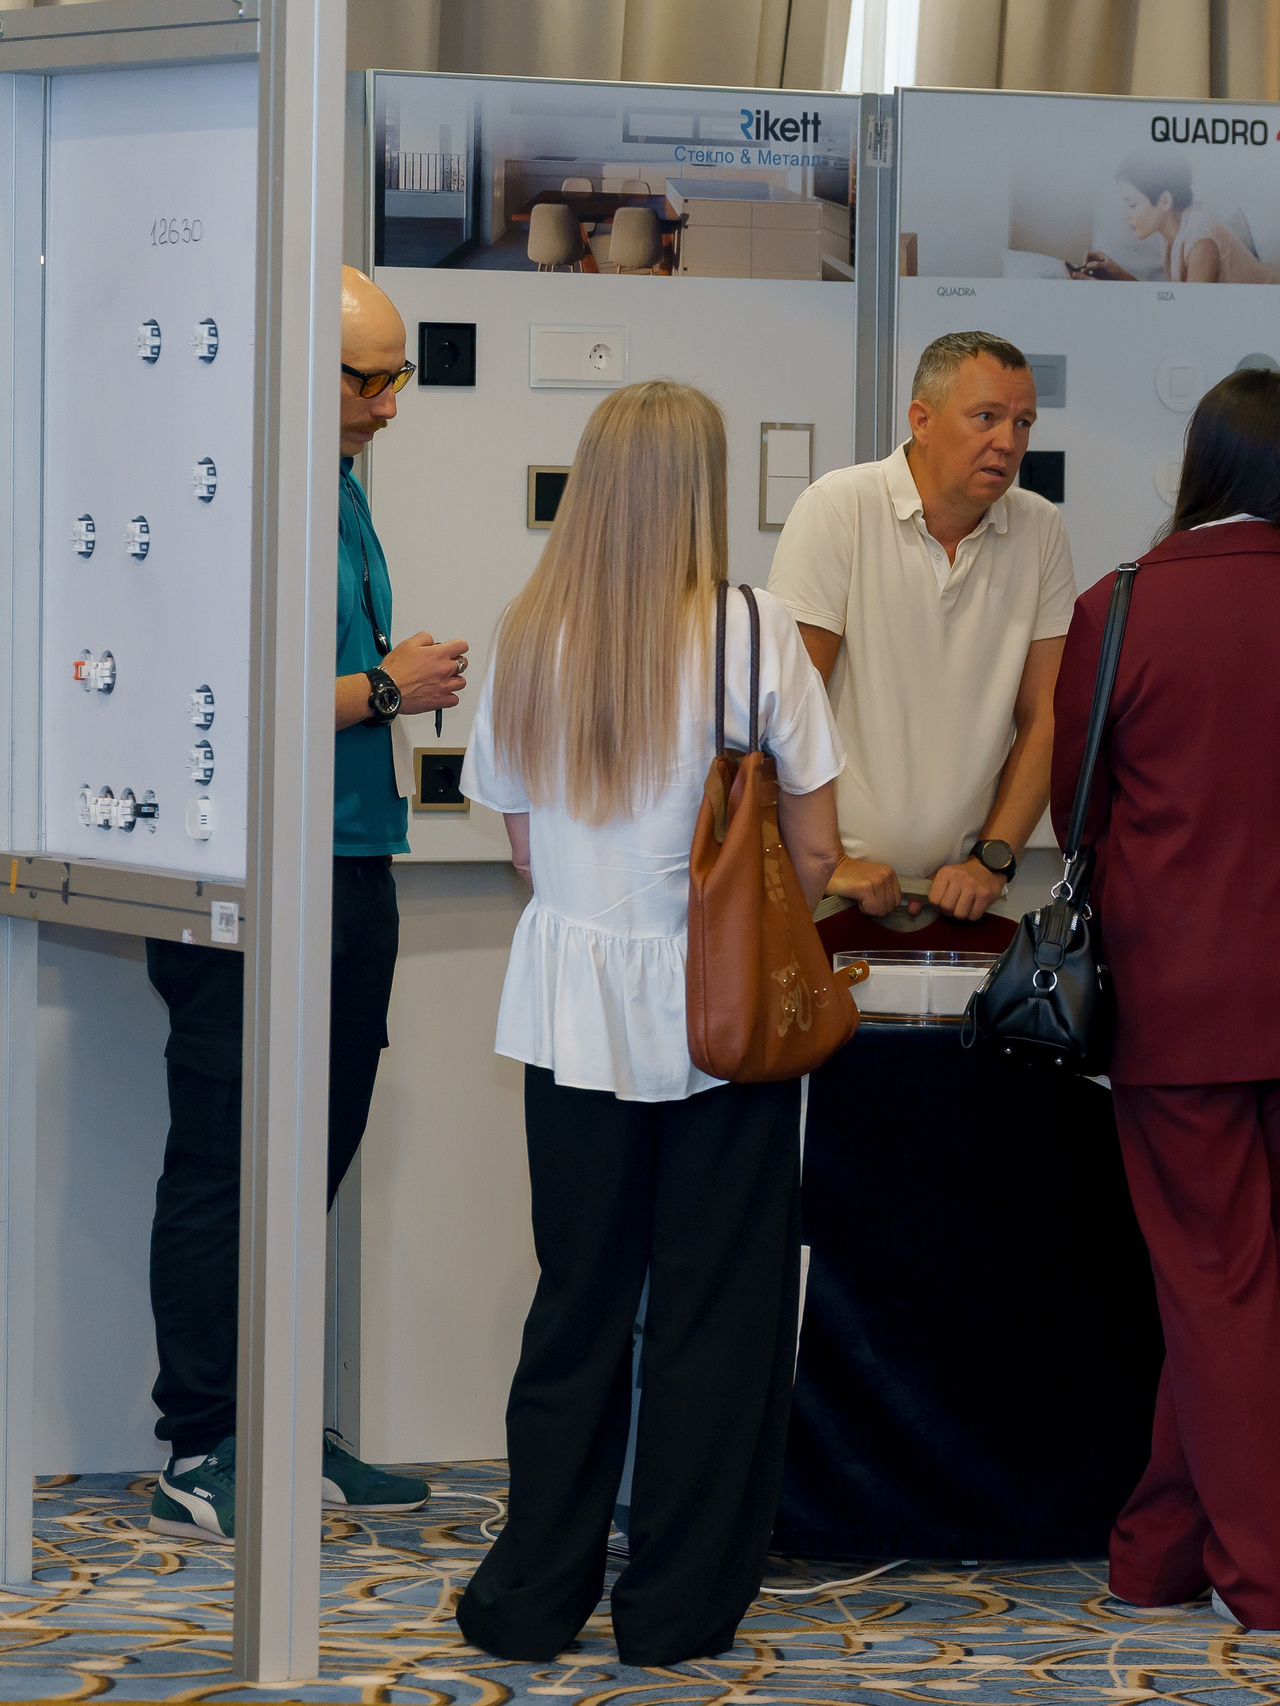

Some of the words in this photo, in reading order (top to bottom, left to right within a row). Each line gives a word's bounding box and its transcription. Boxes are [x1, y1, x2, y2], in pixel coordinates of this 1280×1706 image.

[740, 108, 821, 143] Rikett
[1151, 115, 1269, 146] QUADRO
[674, 145, 734, 164] Стекло
[740, 148, 751, 165] &
[758, 150, 821, 167] Металл
[150, 218, 203, 246] 12630
[936, 286, 977, 297] QUADRA
